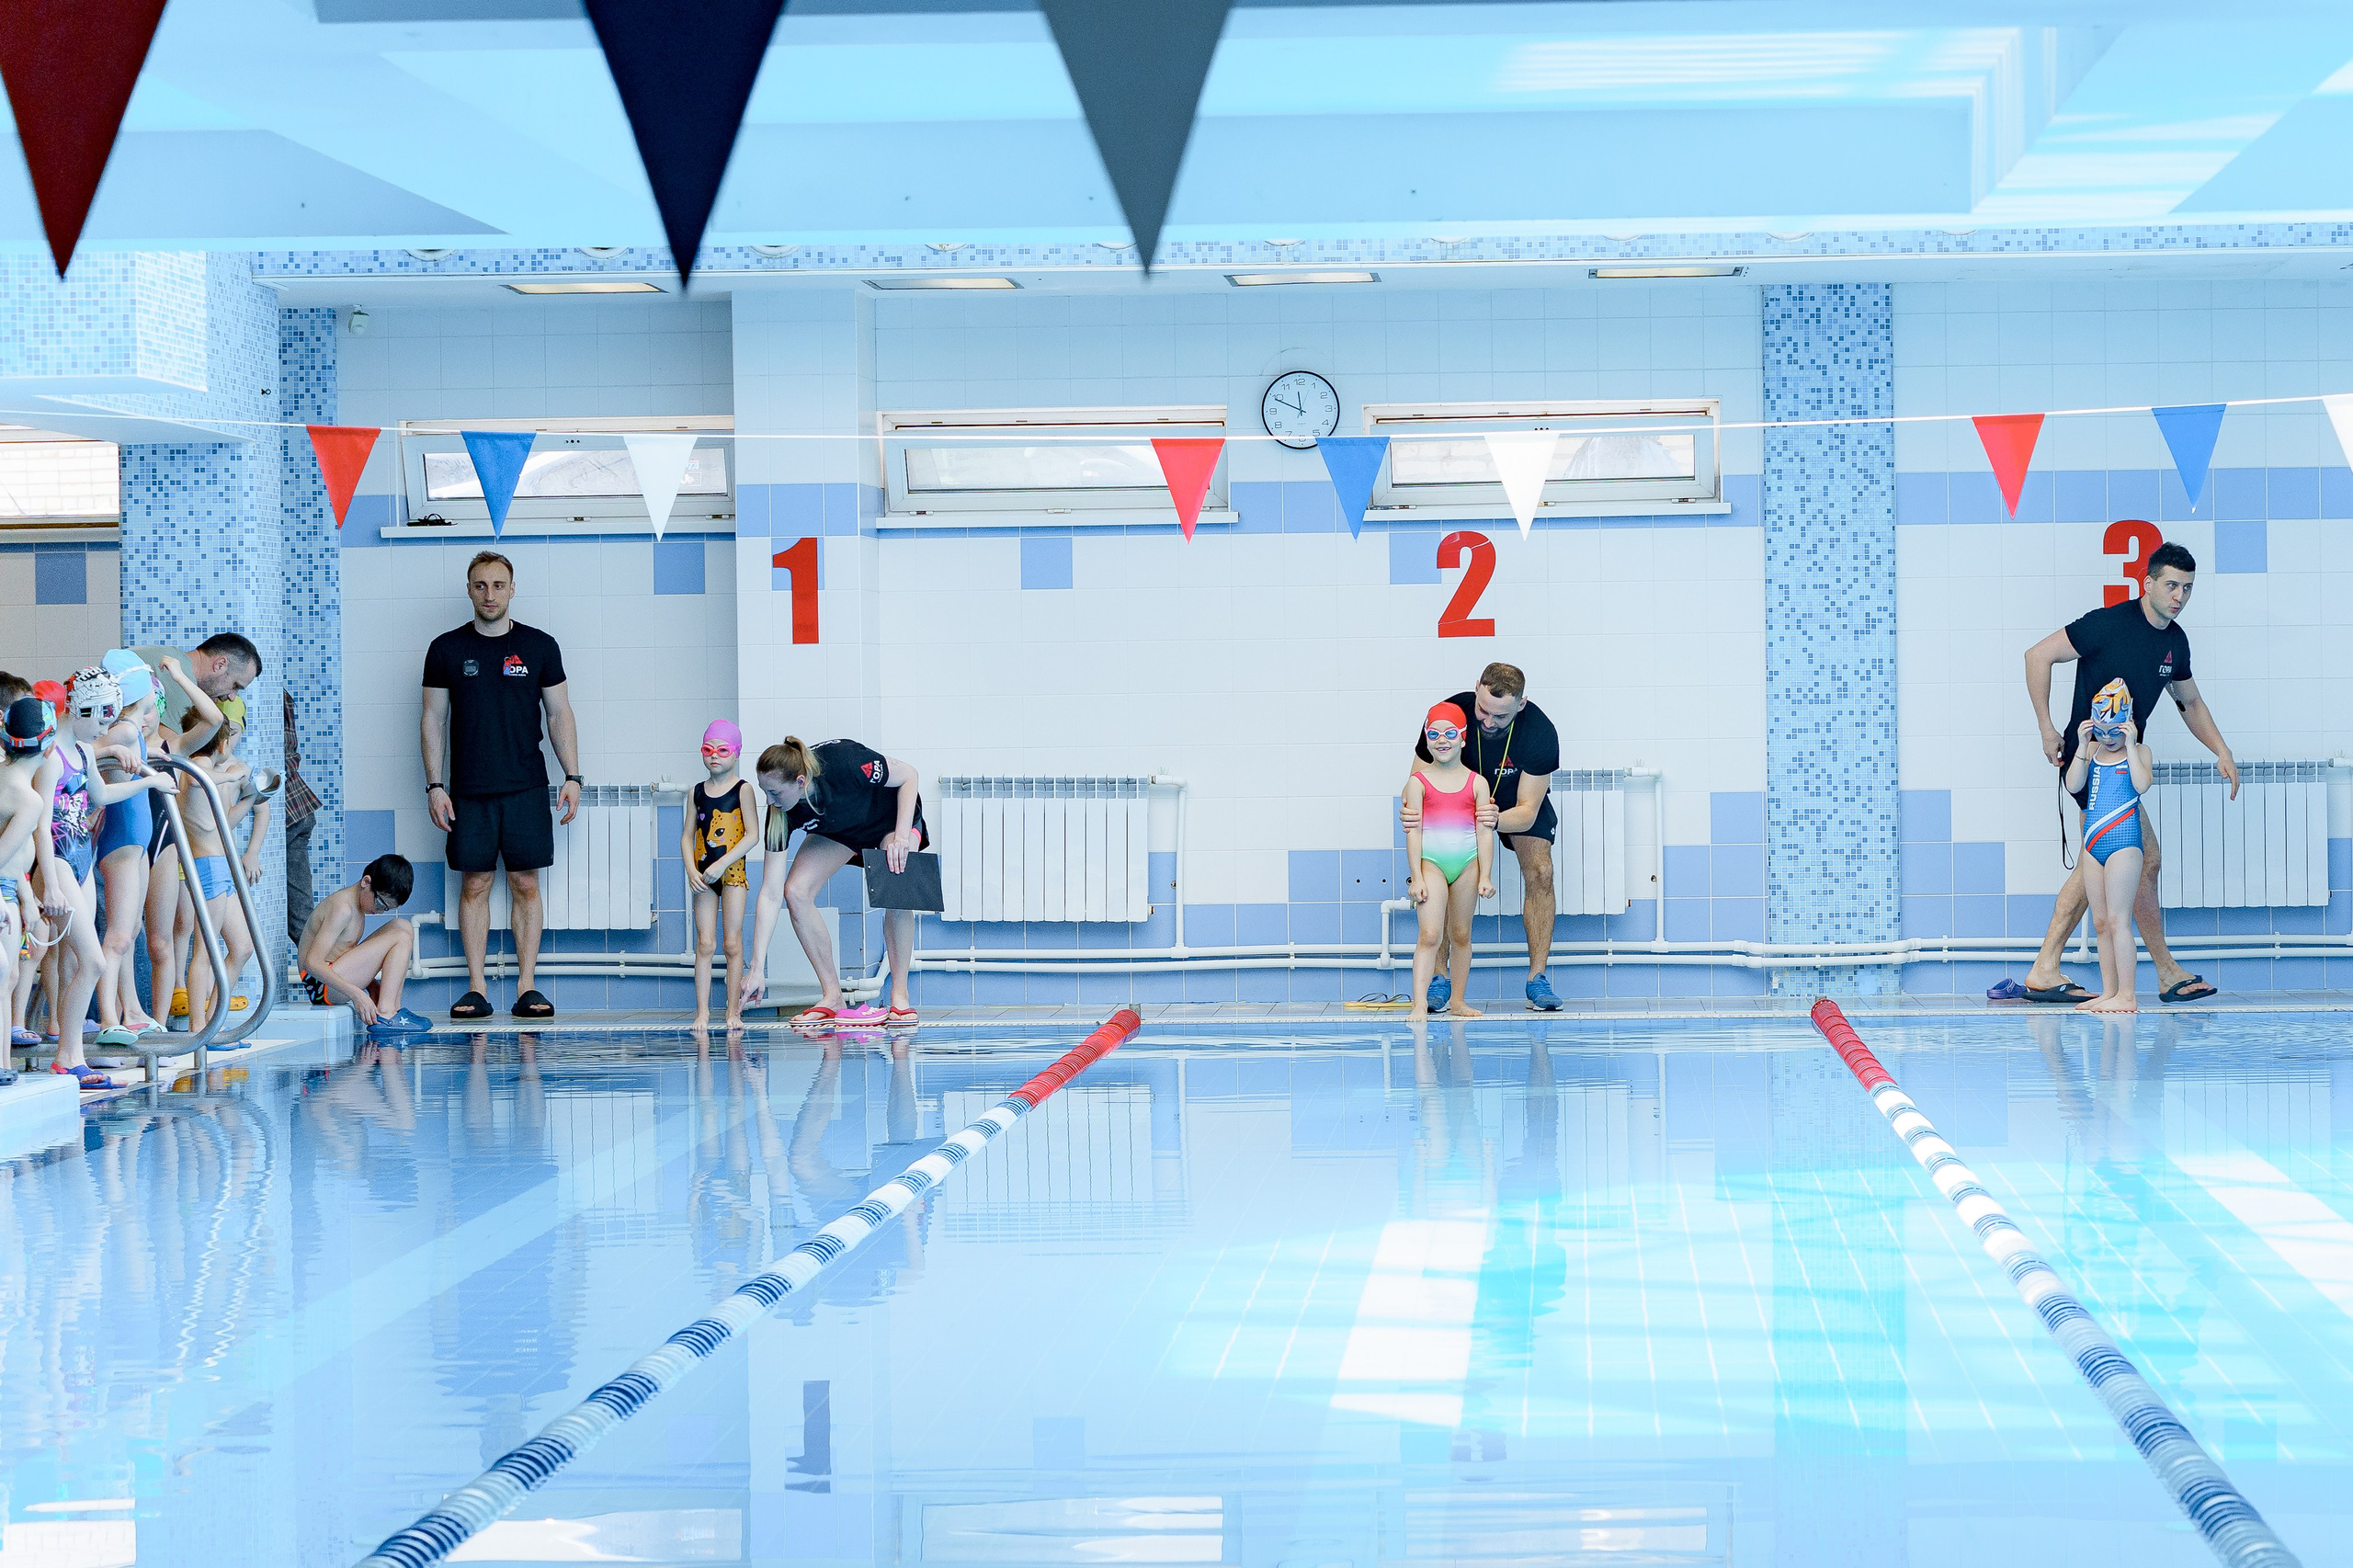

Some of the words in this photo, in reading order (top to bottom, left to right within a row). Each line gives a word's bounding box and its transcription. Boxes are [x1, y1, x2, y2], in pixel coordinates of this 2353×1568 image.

[1294, 378, 1306, 386] 12
[1272, 393, 1284, 402] 10
[1320, 392, 1328, 400] 2
[1269, 407, 1278, 415] 9
[1324, 404, 1334, 413] 3
[1274, 421, 1282, 429] 8
[2102, 519, 2164, 608] 3
[1437, 530, 1496, 638] 2
[772, 537, 820, 644] 1
[509, 665, 529, 674] ОРА
[2088, 766, 2101, 811] RUSSIA
